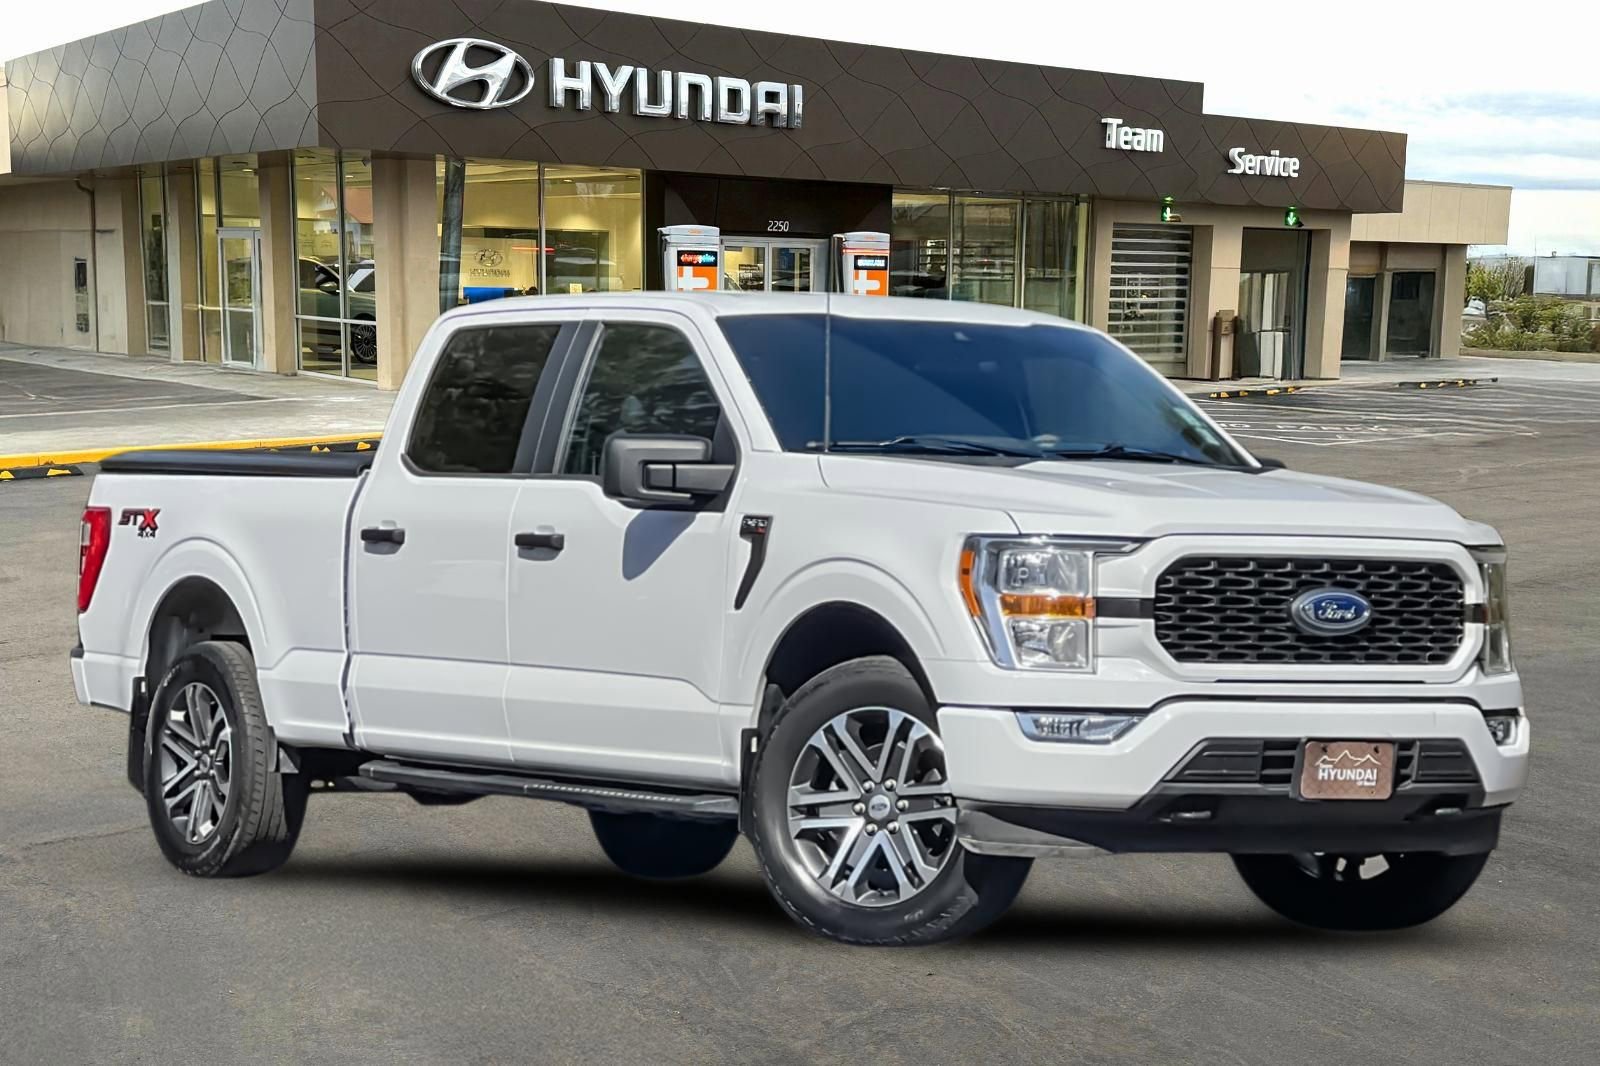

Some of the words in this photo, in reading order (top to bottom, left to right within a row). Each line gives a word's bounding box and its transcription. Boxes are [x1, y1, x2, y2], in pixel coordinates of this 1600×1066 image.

[549, 57, 803, 129] HYUNDAI
[1101, 117, 1164, 153] Team
[1227, 147, 1300, 178] Service
[767, 220, 790, 232] 2250
[117, 507, 162, 531] STX
[1318, 600, 1357, 620] Ford
[1318, 767, 1378, 781] HYUNDAI
